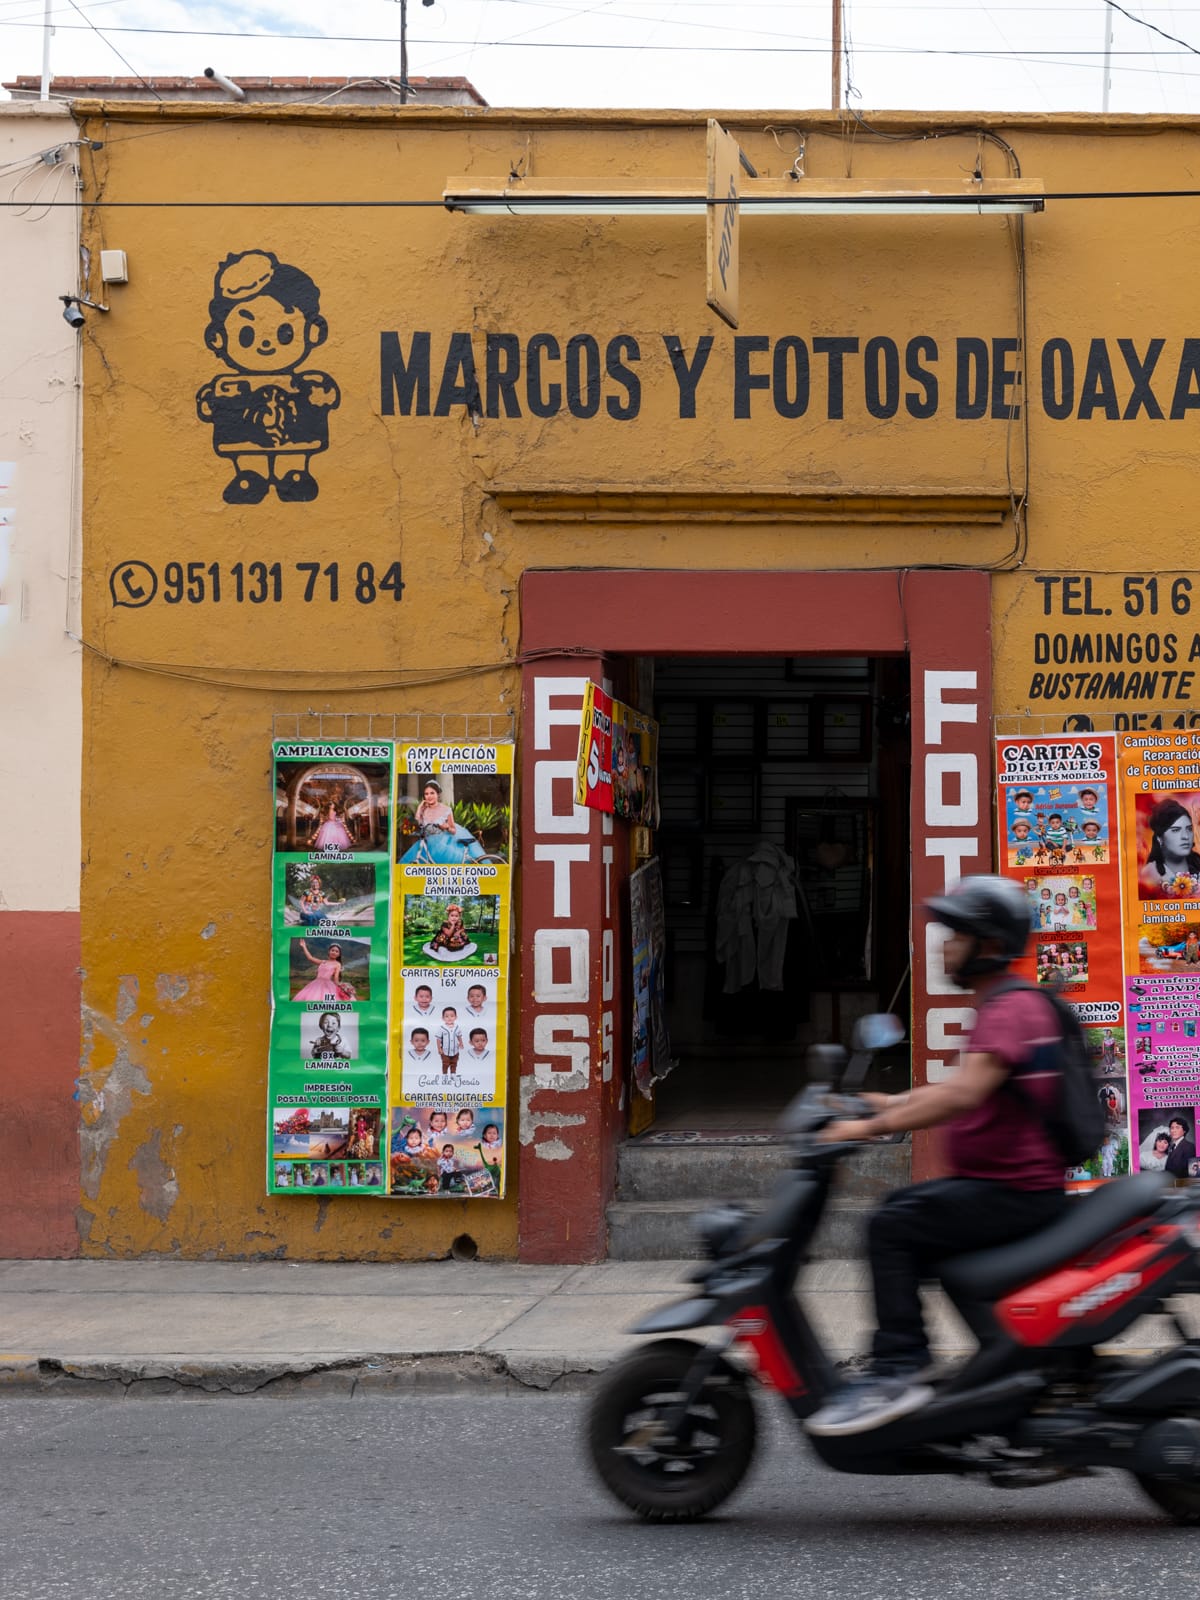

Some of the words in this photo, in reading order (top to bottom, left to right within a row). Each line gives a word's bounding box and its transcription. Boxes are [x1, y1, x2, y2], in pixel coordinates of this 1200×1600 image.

[380, 331, 641, 421] MARCOS
[662, 335, 714, 419] Y
[733, 335, 939, 420] FOTOS
[955, 337, 1022, 420] DE
[164, 562, 220, 604] 951
[231, 562, 282, 603] 131
[296, 562, 339, 602] 71
[355, 561, 406, 604] 84
[1034, 576, 1112, 616] TEL.
[1123, 577, 1158, 617] 51
[1171, 577, 1193, 616] 6
[1034, 633, 1178, 664] DOMINGOS
[1029, 671, 1195, 700] BUSTAMANTE
[1124, 735, 1171, 747] Cambios
[1174, 735, 1188, 746] de
[277, 746, 389, 758] AMPLIACIONES
[407, 745, 496, 760] AMPLIACIÓN
[1003, 743, 1101, 761] CARITAS
[407, 761, 432, 773] 16X
[441, 763, 496, 773] LAMINADAS
[1007, 760, 1098, 773] DIGITALES
[1127, 766, 1141, 777] de
[1143, 765, 1175, 776] Fotos
[1000, 773, 1060, 783] DIFERENTES
[1061, 772, 1106, 781] MODELOS
[1142, 782, 1149, 790] e
[324, 843, 339, 851] 16X
[308, 853, 354, 861] LAMINADA
[405, 867, 447, 876] CAMBIOS
[450, 867, 462, 876] DE
[465, 867, 497, 876] FONDO
[426, 877, 438, 885] 8X
[441, 877, 458, 885] 11X
[461, 877, 478, 885] 16X
[534, 677, 590, 1090] FOTOS
[425, 886, 480, 895] LAMINADAS
[1163, 903, 1181, 911] con
[1143, 913, 1186, 923] laminada
[306, 929, 351, 937] LAMINADA
[401, 969, 440, 978] CARITAS
[442, 969, 499, 978] ESFUMADAS
[440, 979, 457, 987] 16X
[1164, 984, 1197, 992] DVD
[307, 1003, 352, 1011] LAMINADA
[1078, 1003, 1120, 1013] FONDO
[1077, 1014, 1118, 1022] ODELOS
[322, 1052, 334, 1060] 8X
[1144, 1053, 1190, 1061] Eventos
[305, 1061, 350, 1070] LAMINADA
[304, 1082, 352, 1092] IMPRESIÓN
[277, 1095, 309, 1103] POSTAL
[312, 1095, 317, 1103] Y
[319, 1095, 347, 1103] DOBLE
[348, 1095, 379, 1103] POSTAL
[404, 1093, 444, 1102] CARITAS
[446, 1093, 494, 1102] DIGITALES
